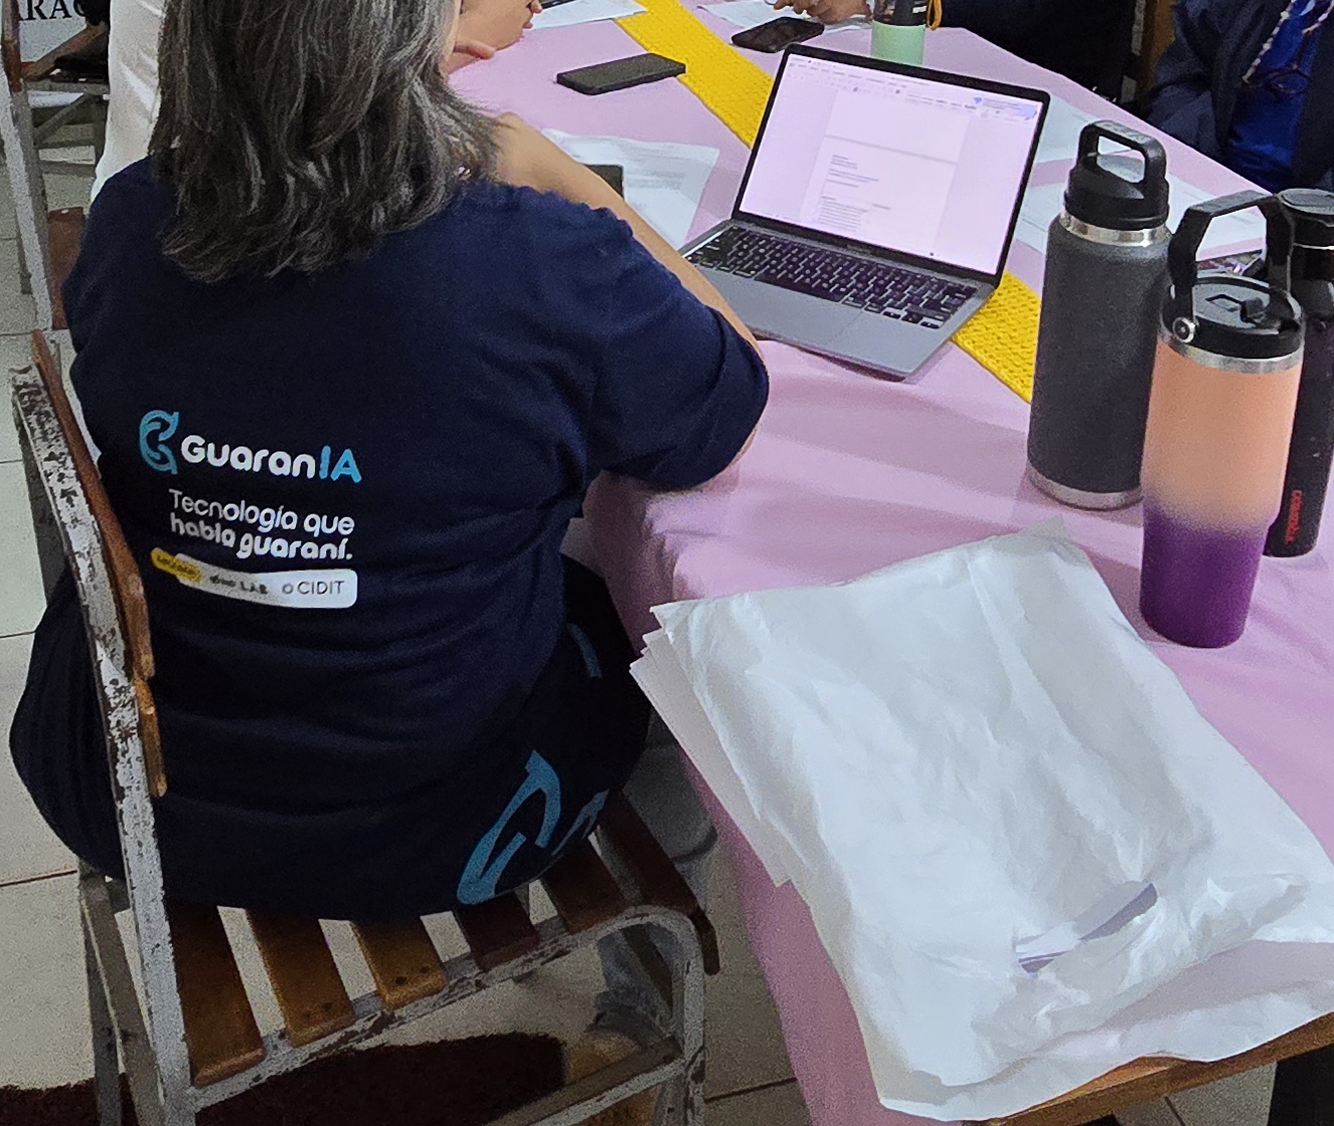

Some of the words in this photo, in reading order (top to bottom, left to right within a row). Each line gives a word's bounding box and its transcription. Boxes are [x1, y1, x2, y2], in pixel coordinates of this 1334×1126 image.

[181, 434, 362, 483] GuaranIA
[168, 488, 298, 533] Tecnología
[303, 513, 355, 537] que
[170, 512, 235, 548] habla
[236, 532, 353, 560] guaraní.
[297, 580, 345, 596] CIDIT
